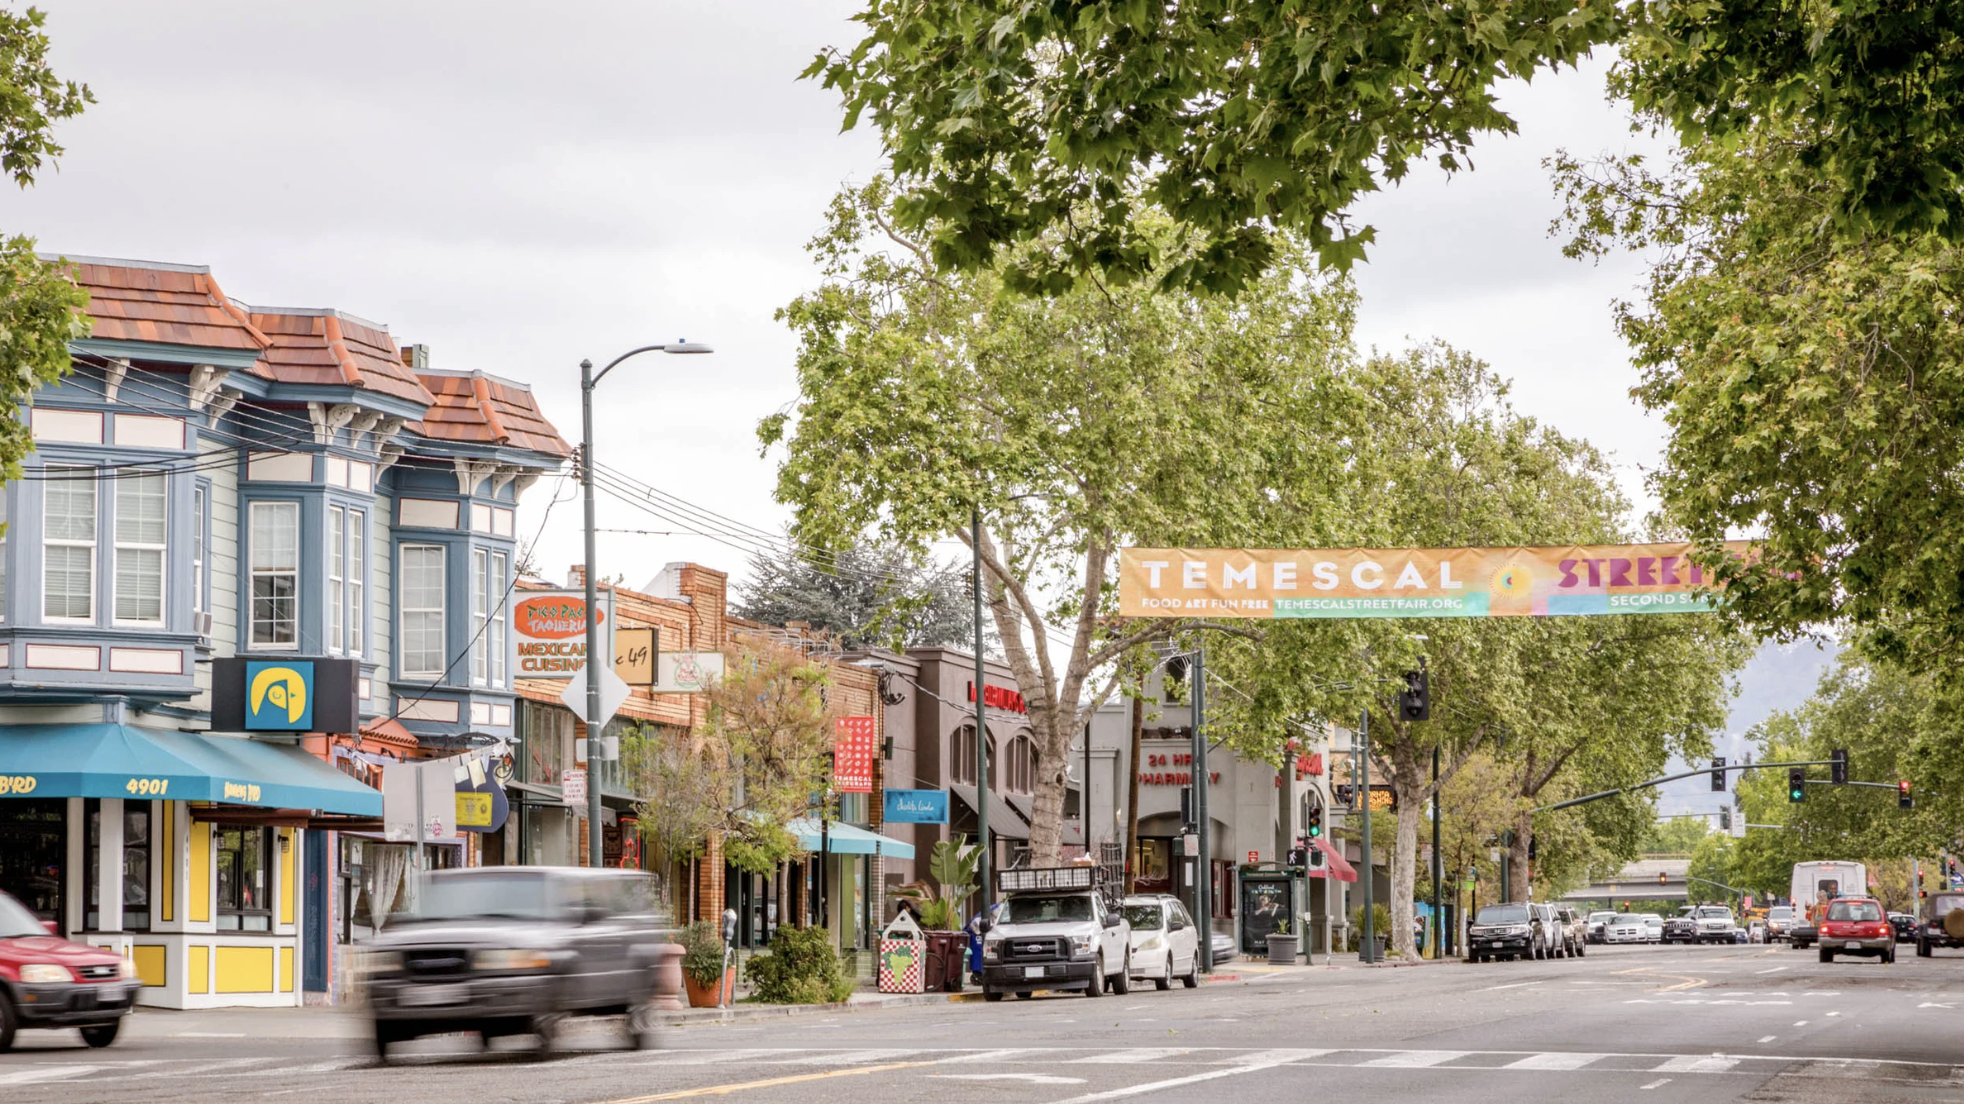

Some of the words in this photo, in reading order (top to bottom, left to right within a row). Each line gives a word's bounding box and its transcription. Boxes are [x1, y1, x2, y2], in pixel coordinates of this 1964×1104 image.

[1141, 560, 1464, 590] TEMESCAL
[1141, 598, 1182, 609] FOOD
[1185, 598, 1208, 609] ART
[1211, 599, 1238, 610] FUN
[1241, 599, 1269, 610] FREE
[1276, 598, 1463, 610] TEMESCALSTREETFAIR.ORG
[1610, 593, 1675, 607] SECOND
[527, 605, 558, 619] PICO
[527, 619, 587, 633] TAQUERIA
[628, 646, 647, 668] 49
[1148, 754, 1166, 767] 24
[126, 778, 169, 795] 4901
